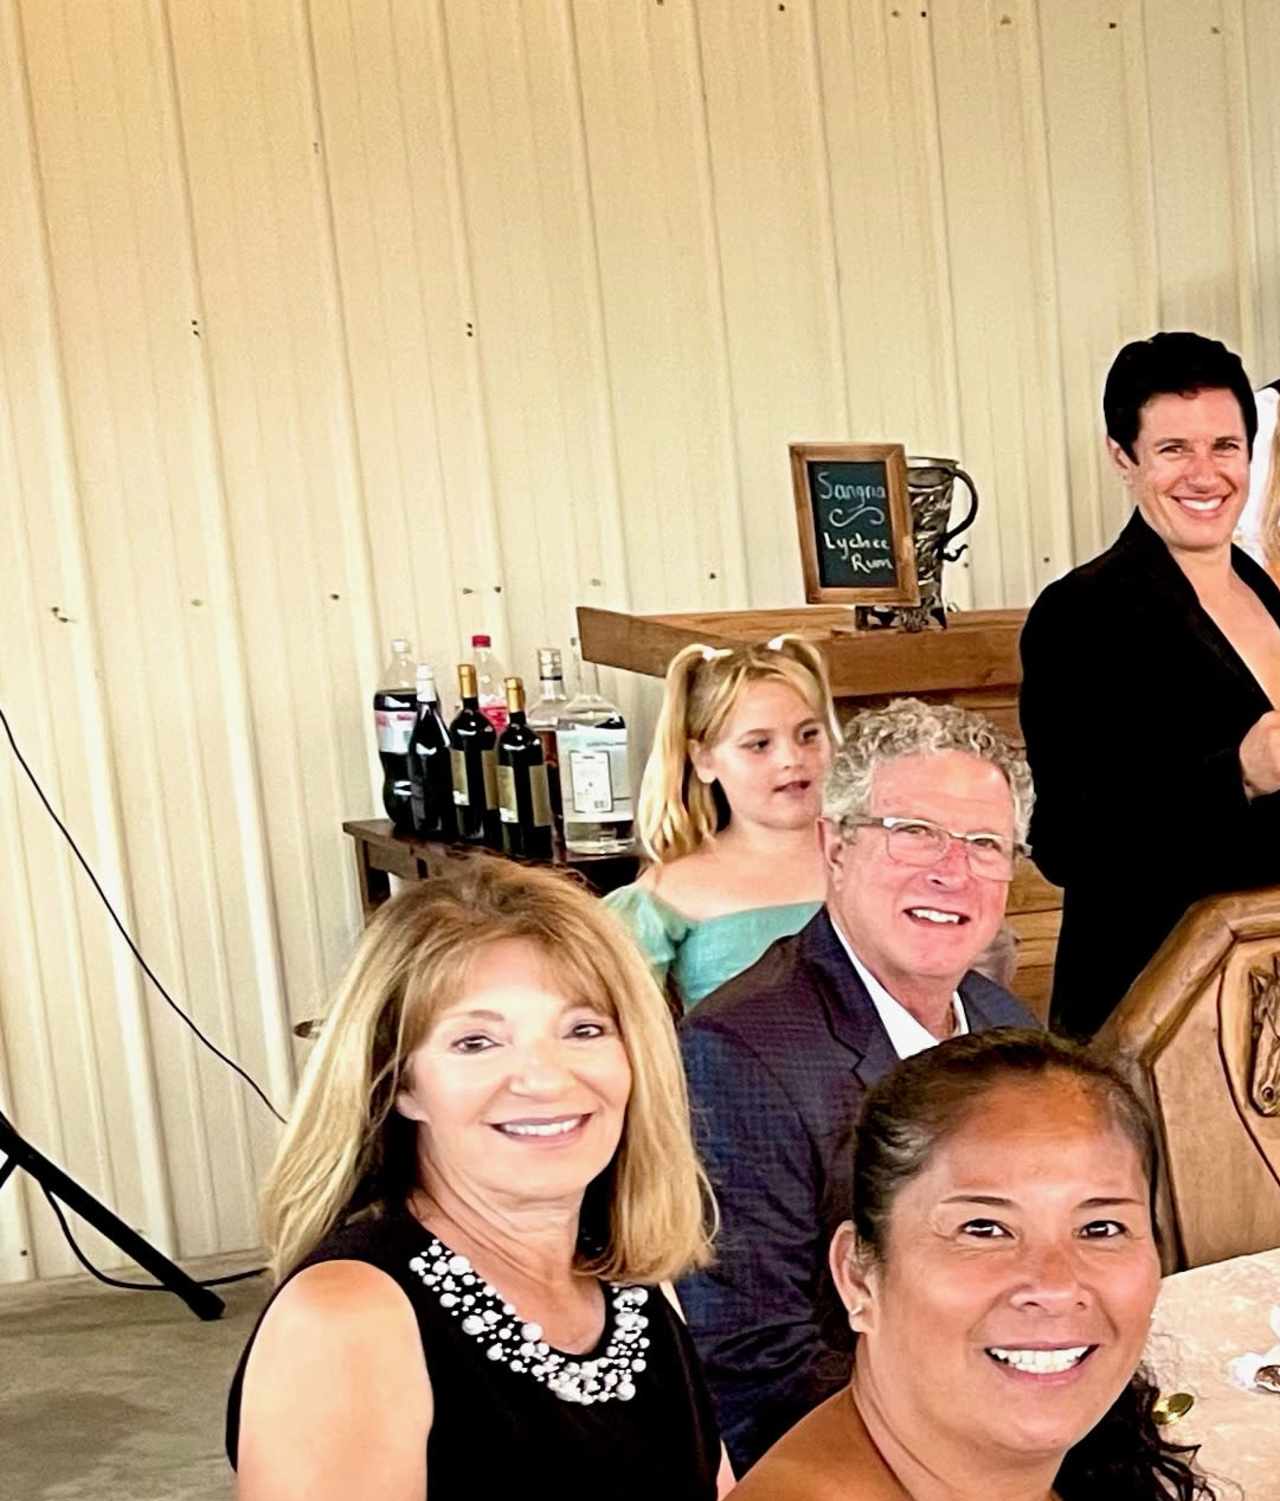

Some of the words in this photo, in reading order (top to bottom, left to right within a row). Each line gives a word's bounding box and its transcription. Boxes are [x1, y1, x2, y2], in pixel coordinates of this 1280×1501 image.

[817, 471, 886, 512] Sangria
[823, 532, 890, 560] Lychee
[851, 554, 893, 573] Rum
